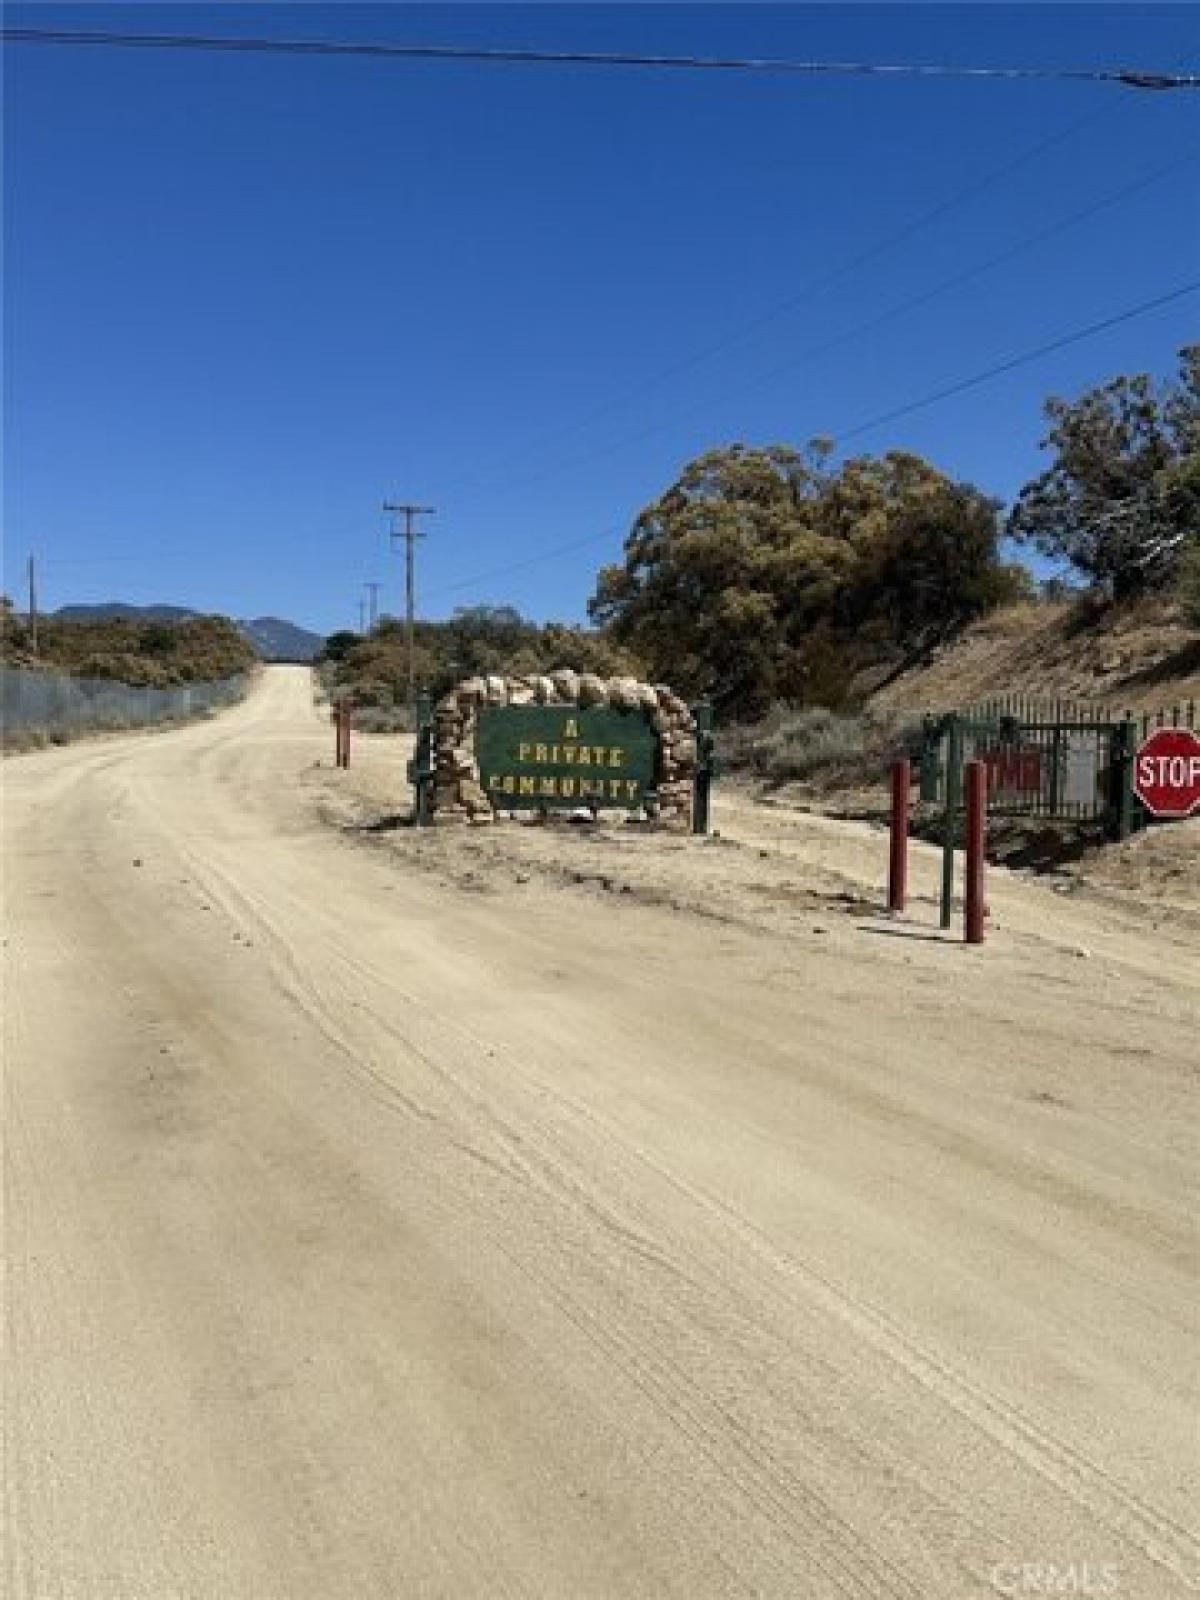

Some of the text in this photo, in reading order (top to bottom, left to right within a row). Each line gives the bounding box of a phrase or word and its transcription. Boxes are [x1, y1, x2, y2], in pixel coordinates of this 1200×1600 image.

[565, 719, 578, 738] A
[519, 743, 622, 767] PRIVATE
[1140, 756, 1200, 787] STOP
[489, 775, 639, 799] COMMUNITY
